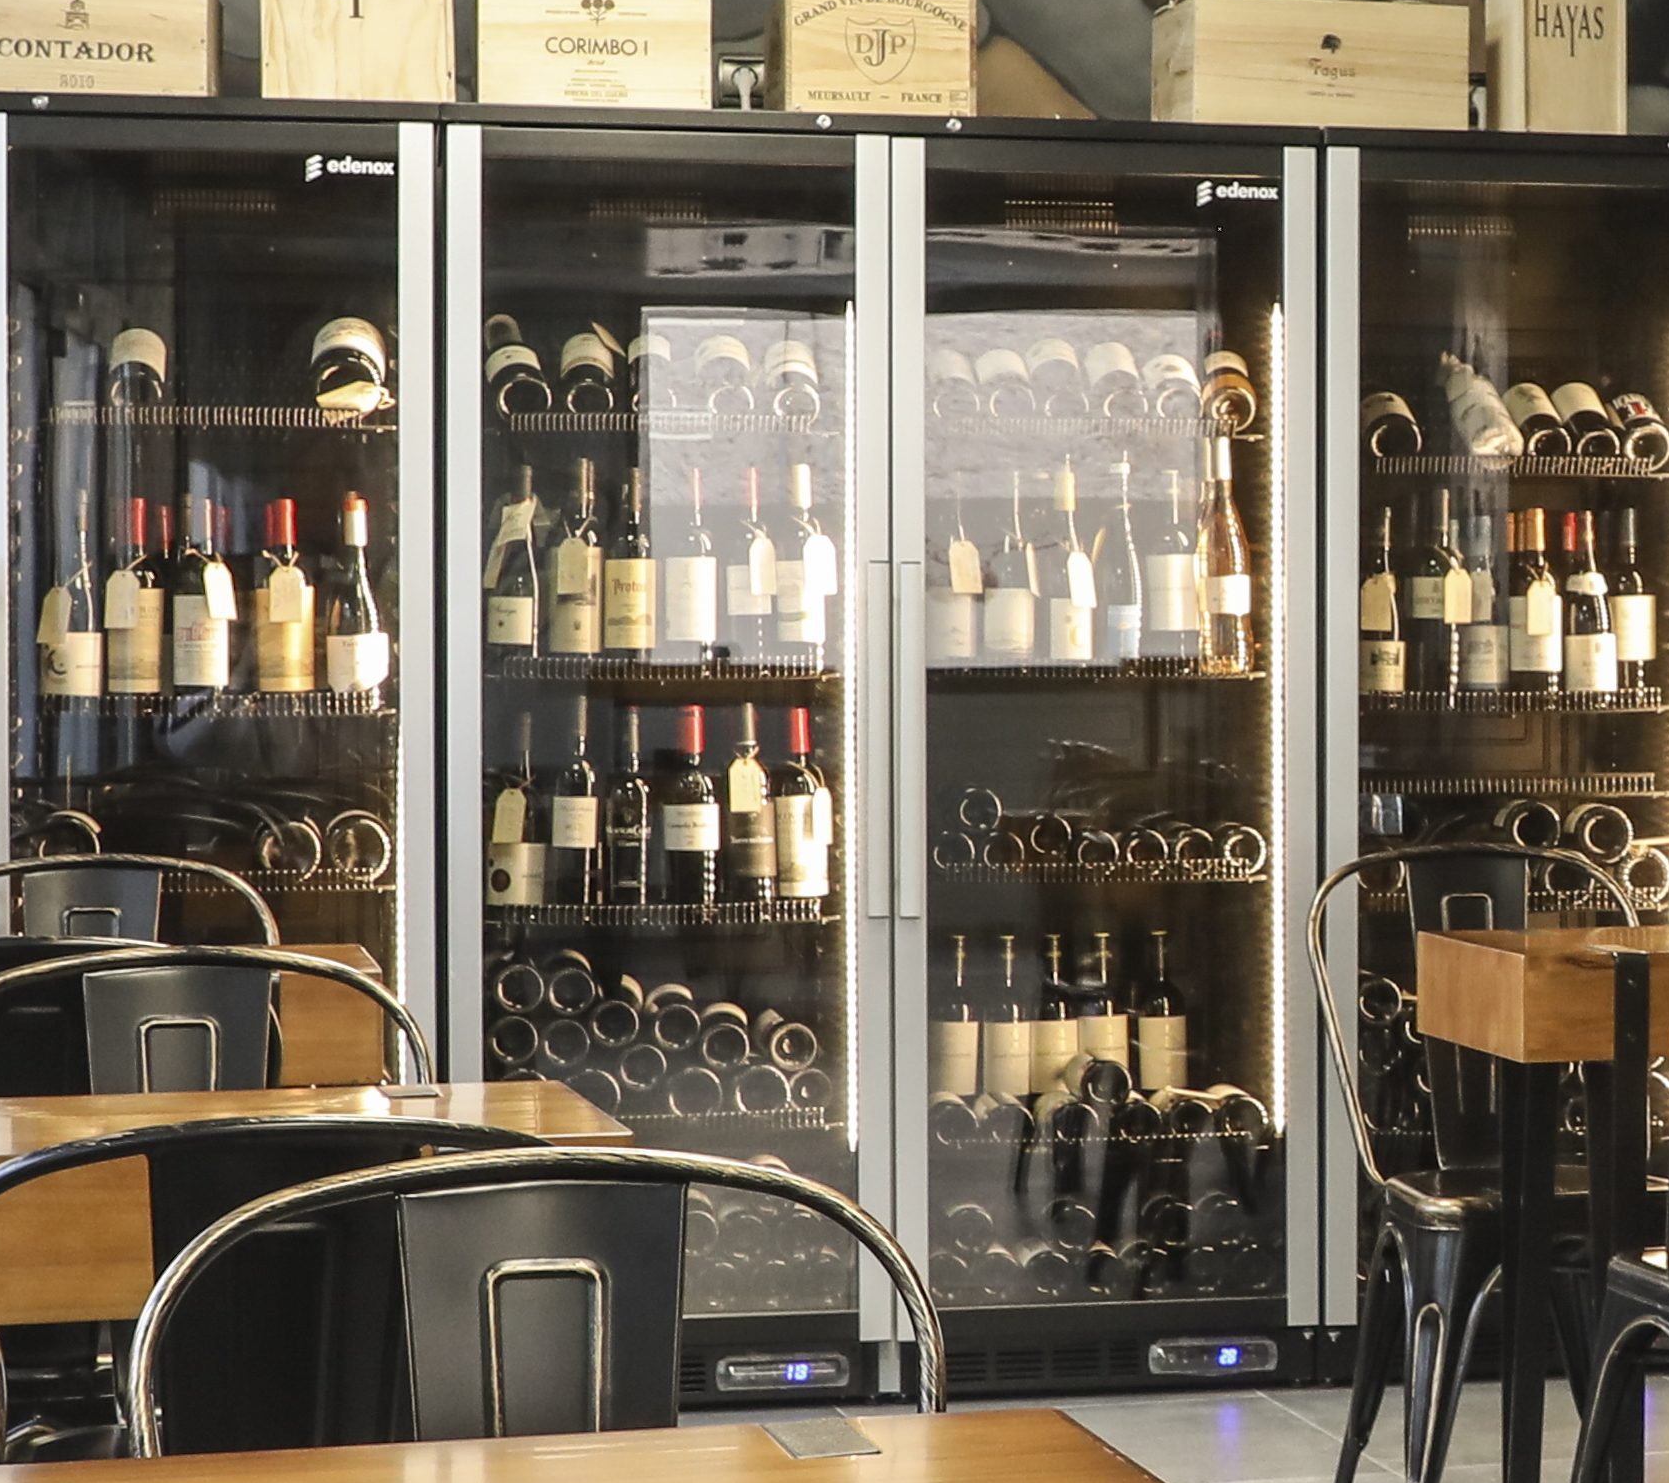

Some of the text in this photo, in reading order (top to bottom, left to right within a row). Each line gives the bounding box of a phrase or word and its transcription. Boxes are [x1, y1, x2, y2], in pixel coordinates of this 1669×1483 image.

[794, 0, 838, 27] GRAND
[545, 37, 638, 56] CORIMBO
[808, 90, 943, 103] MEURSAULT FRANCE
[327, 155, 395, 175] edenox
[1215, 181, 1279, 200] edenox
